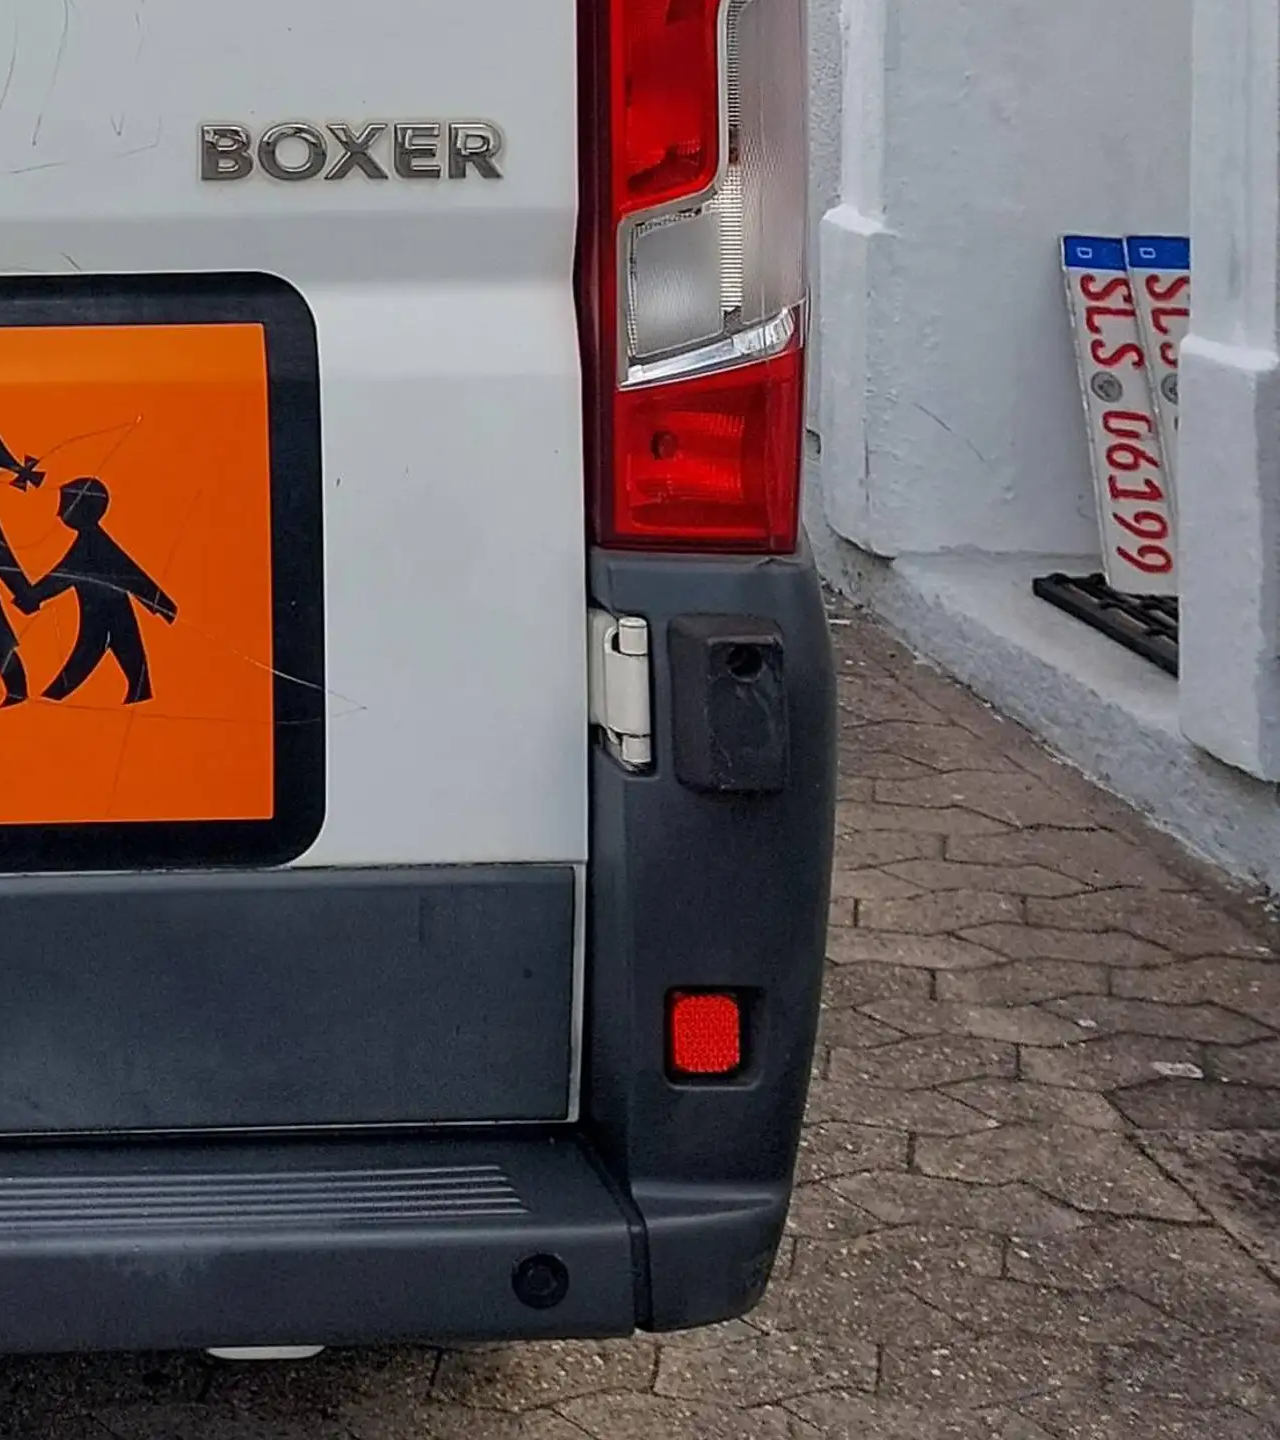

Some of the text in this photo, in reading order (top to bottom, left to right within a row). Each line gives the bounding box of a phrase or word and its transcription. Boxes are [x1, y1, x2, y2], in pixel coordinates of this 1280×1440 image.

[200, 121, 504, 181] BOXER
[1080, 273, 1174, 574] SLS 06199
